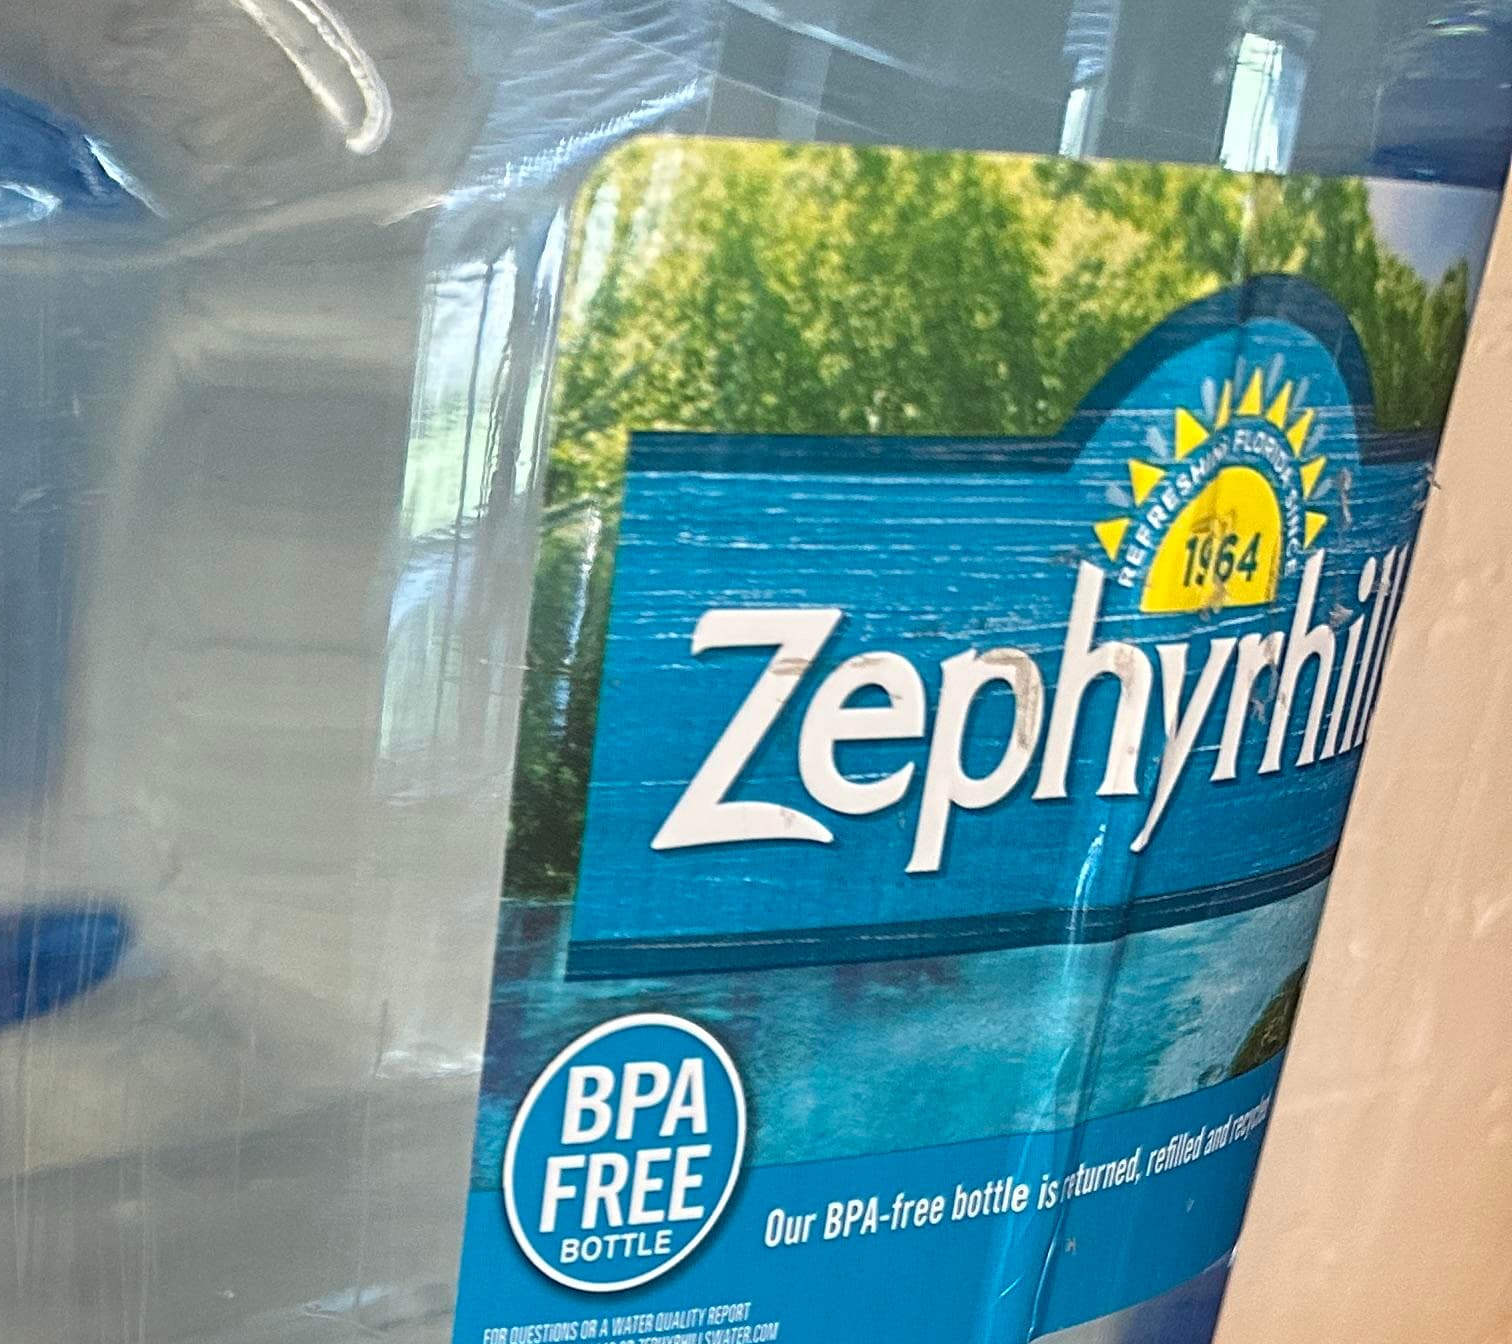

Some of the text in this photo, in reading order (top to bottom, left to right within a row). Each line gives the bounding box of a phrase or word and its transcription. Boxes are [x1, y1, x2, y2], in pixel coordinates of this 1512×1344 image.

[1182, 531, 1261, 588] 1964
[560, 1057, 708, 1145] BPA
[539, 1144, 712, 1233] FREE
[764, 1208, 818, 1248] Our
[823, 1192, 945, 1240] BPA-free
[951, 1176, 1029, 1221] bottle
[1037, 1173, 1060, 1210] is
[1060, 1146, 1143, 1203] returned,
[1144, 1125, 1206, 1177] refilled
[1203, 1114, 1233, 1155] and
[559, 1229, 673, 1264] BOTTLE
[580, 1319, 598, 1339] OR
[598, 1318, 608, 1337] A
[612, 1313, 654, 1337] WATER
[655, 1308, 707, 1332] QUALITY
[707, 1302, 752, 1325] REPORT
